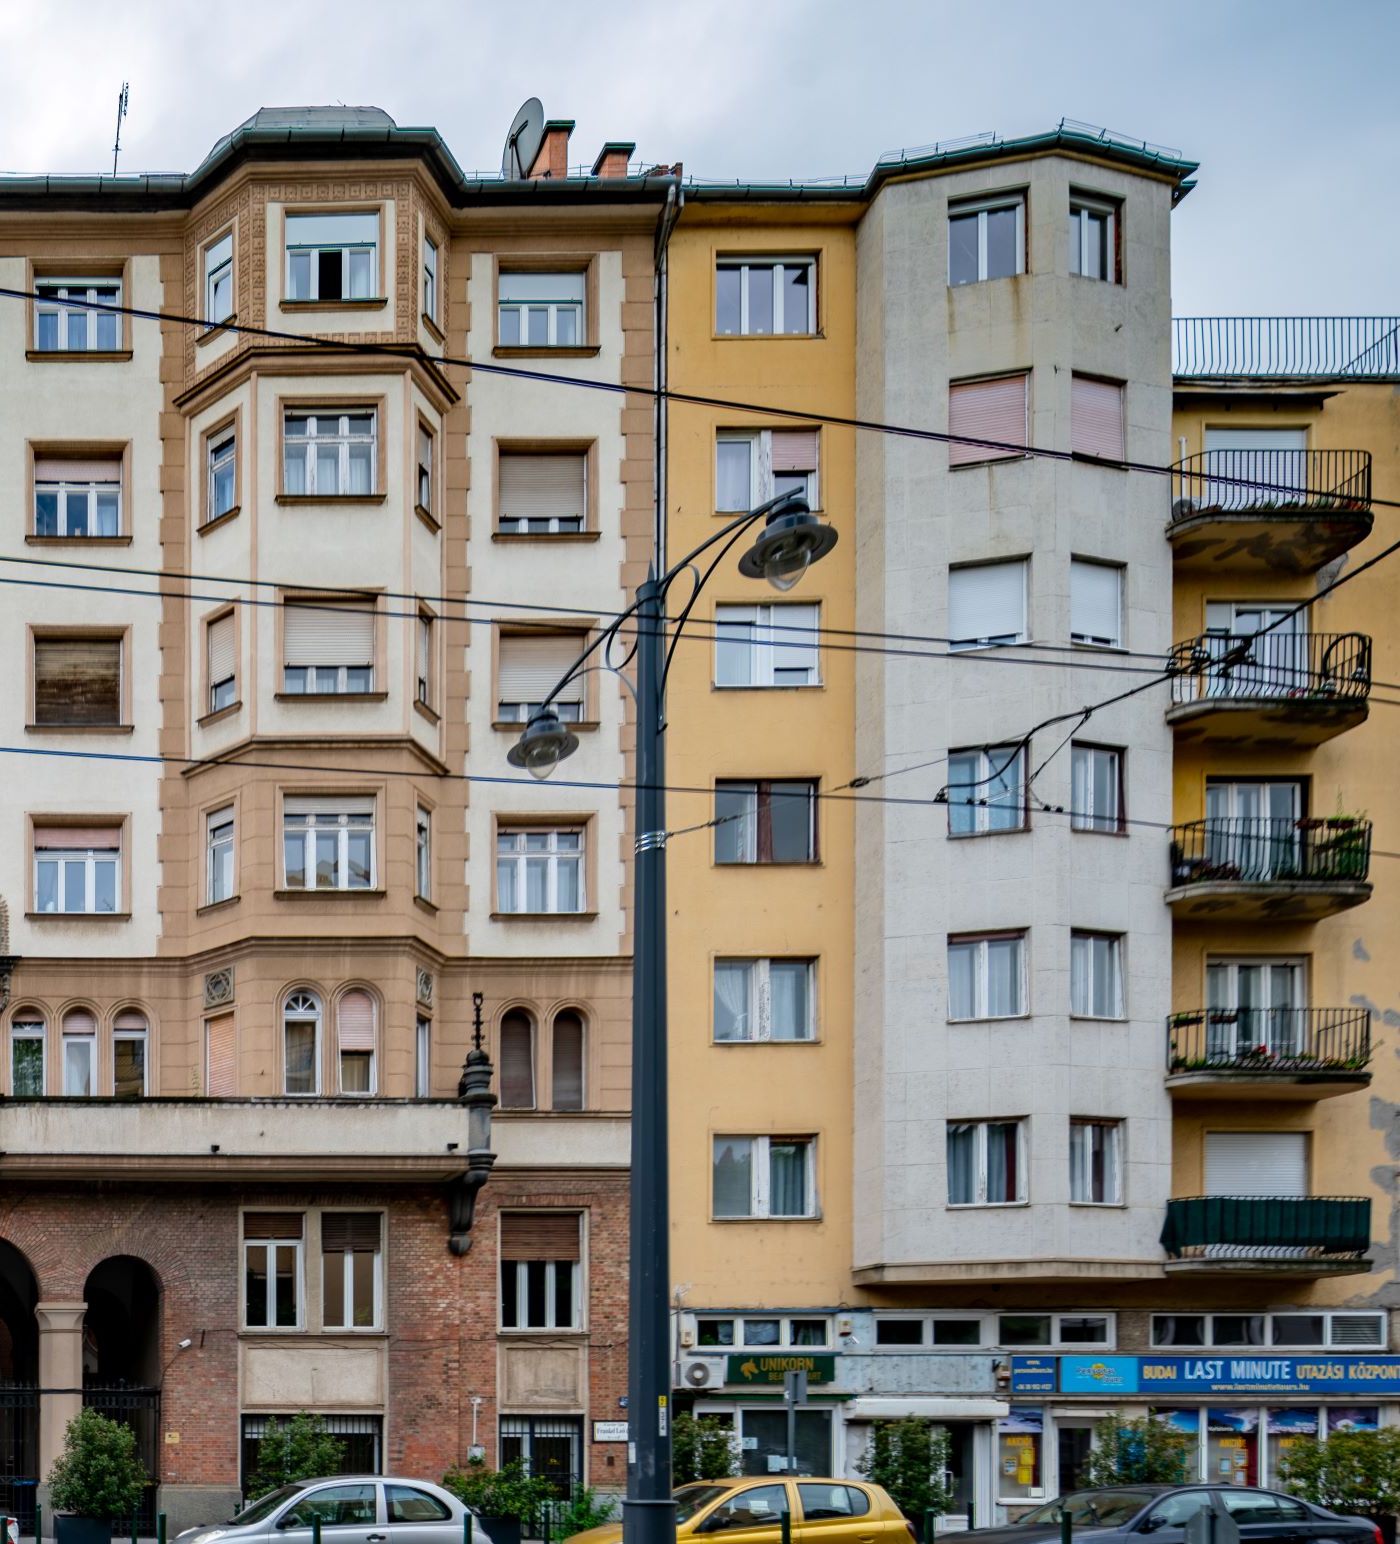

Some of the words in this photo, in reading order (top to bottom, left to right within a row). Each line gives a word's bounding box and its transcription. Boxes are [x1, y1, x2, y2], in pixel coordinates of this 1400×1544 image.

[760, 1357, 814, 1371] UNIKORN
[1143, 1365, 1177, 1379] BUDAI
[1184, 1361, 1224, 1380] LAST
[1230, 1361, 1291, 1380] MINUTE
[1296, 1361, 1345, 1380] UTAZÁSI
